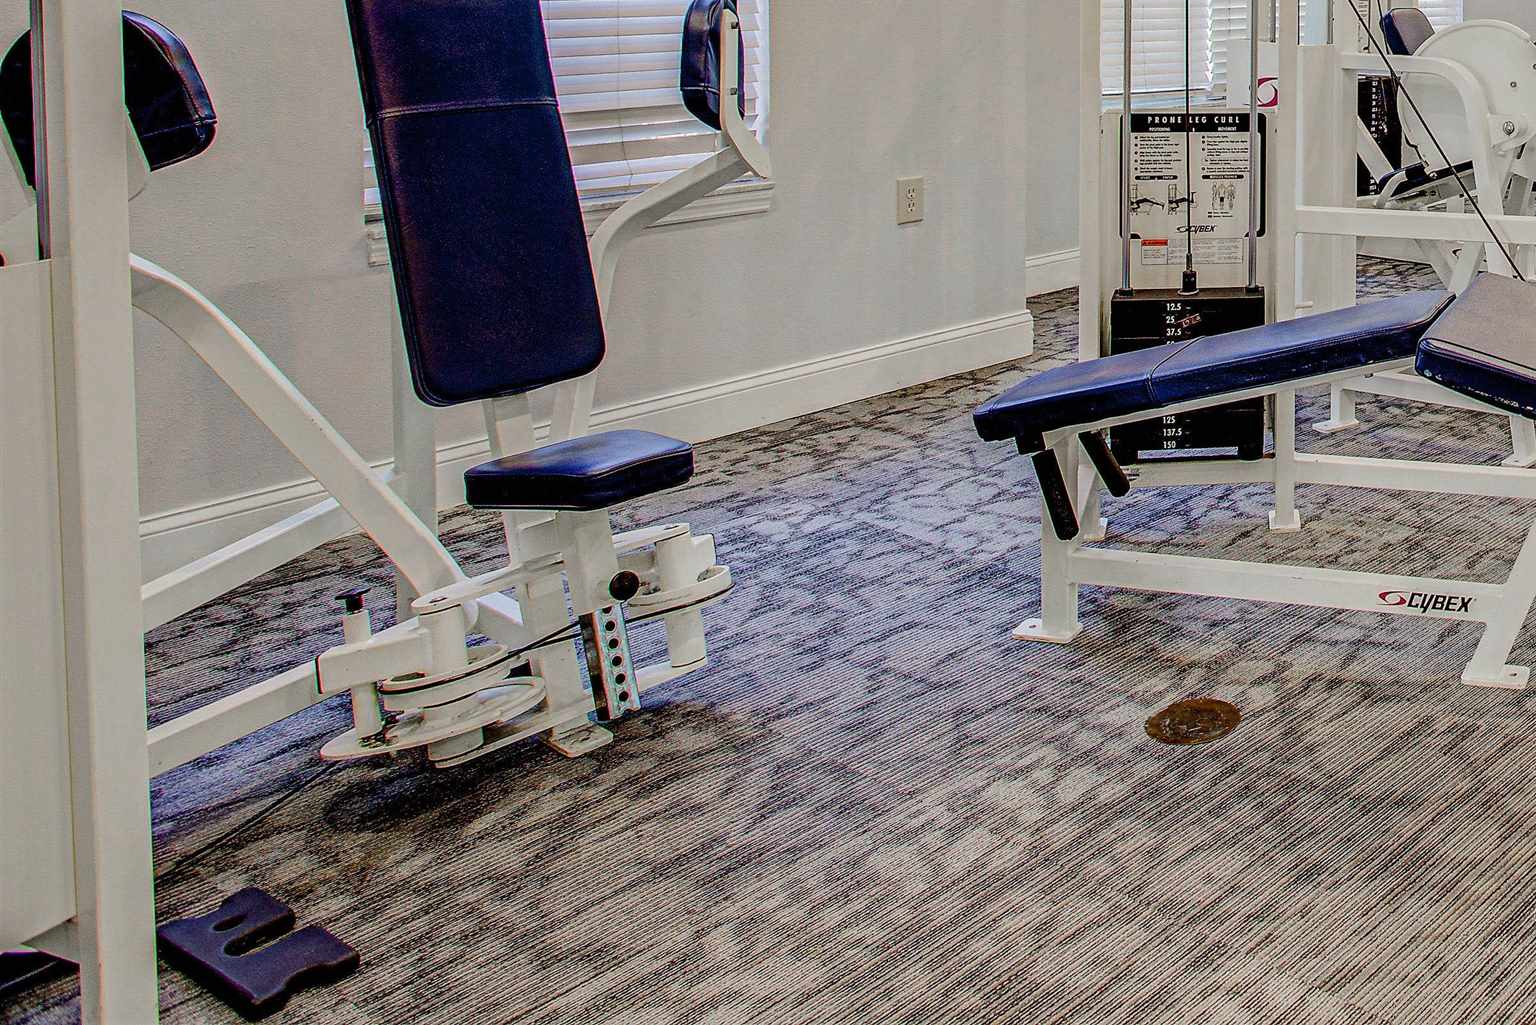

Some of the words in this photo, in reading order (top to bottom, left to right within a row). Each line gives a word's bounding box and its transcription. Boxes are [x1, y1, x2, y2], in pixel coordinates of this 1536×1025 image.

[1147, 116, 1182, 124] PRONE
[1189, 116, 1207, 124] LEG
[1214, 116, 1240, 124] CURL
[1166, 303, 1182, 311] 12.5
[1166, 316, 1175, 324] 25
[1163, 441, 1176, 449] 150
[1407, 592, 1473, 613] CYBEX
